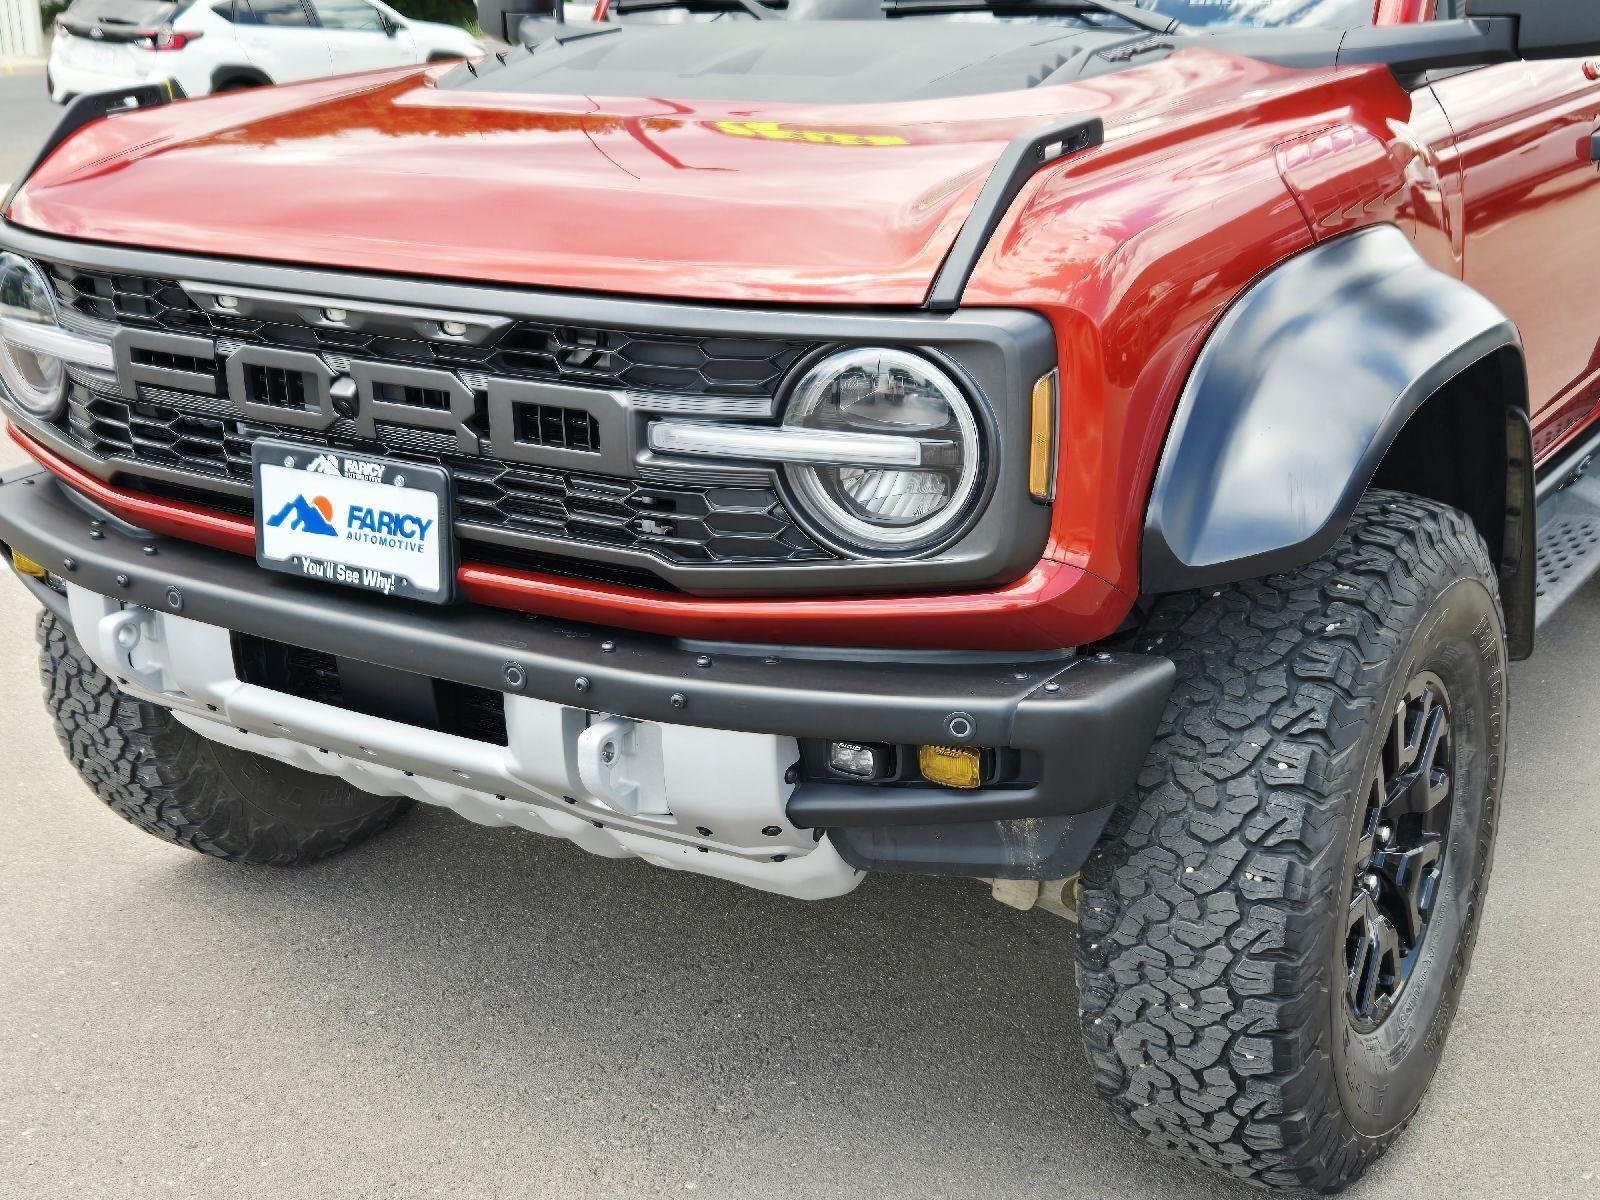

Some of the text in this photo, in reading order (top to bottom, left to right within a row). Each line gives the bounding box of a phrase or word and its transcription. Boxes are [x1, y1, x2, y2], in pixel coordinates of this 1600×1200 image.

[113, 327, 638, 478] FORD
[344, 459, 386, 477] FARICY
[346, 505, 433, 542] FARICY
[346, 532, 424, 554] AUTOMOTIVE
[302, 557, 396, 595] You'll See Why!
